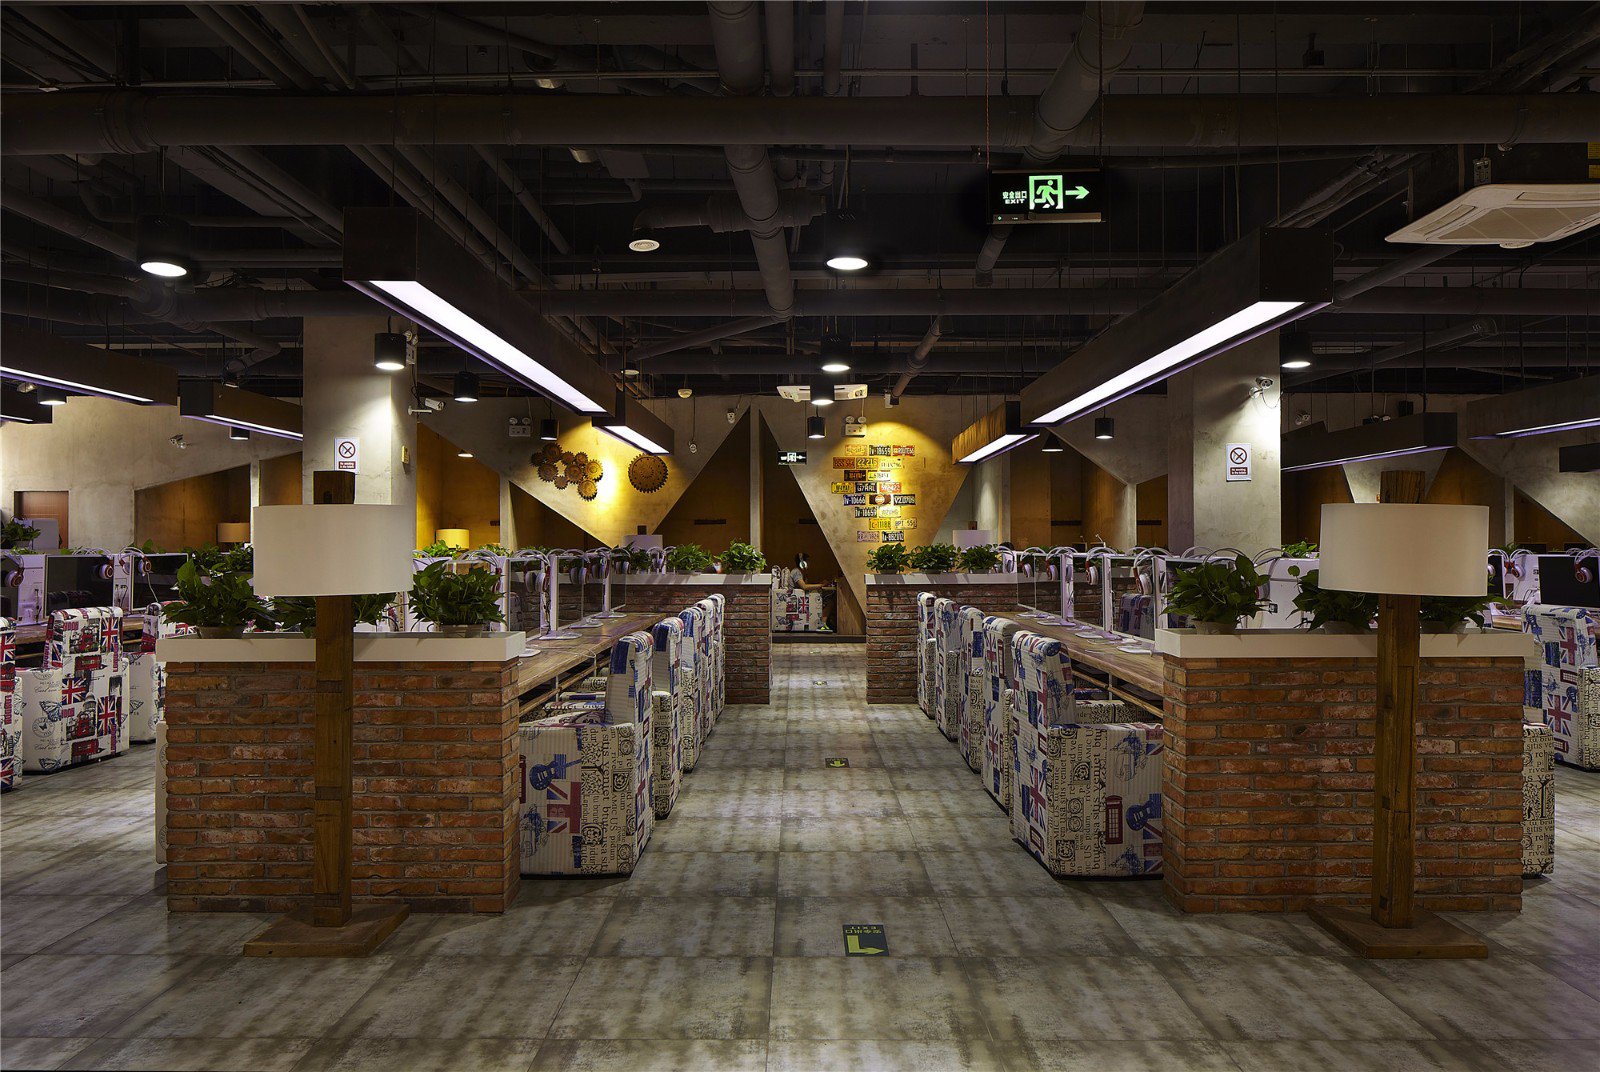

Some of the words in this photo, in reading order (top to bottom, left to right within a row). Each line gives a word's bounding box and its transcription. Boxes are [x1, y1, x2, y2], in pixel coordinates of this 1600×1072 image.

[1002, 190, 1027, 199] 安全出口
[602, 761, 612, 801] veniet
[1091, 753, 1101, 791] veniet
